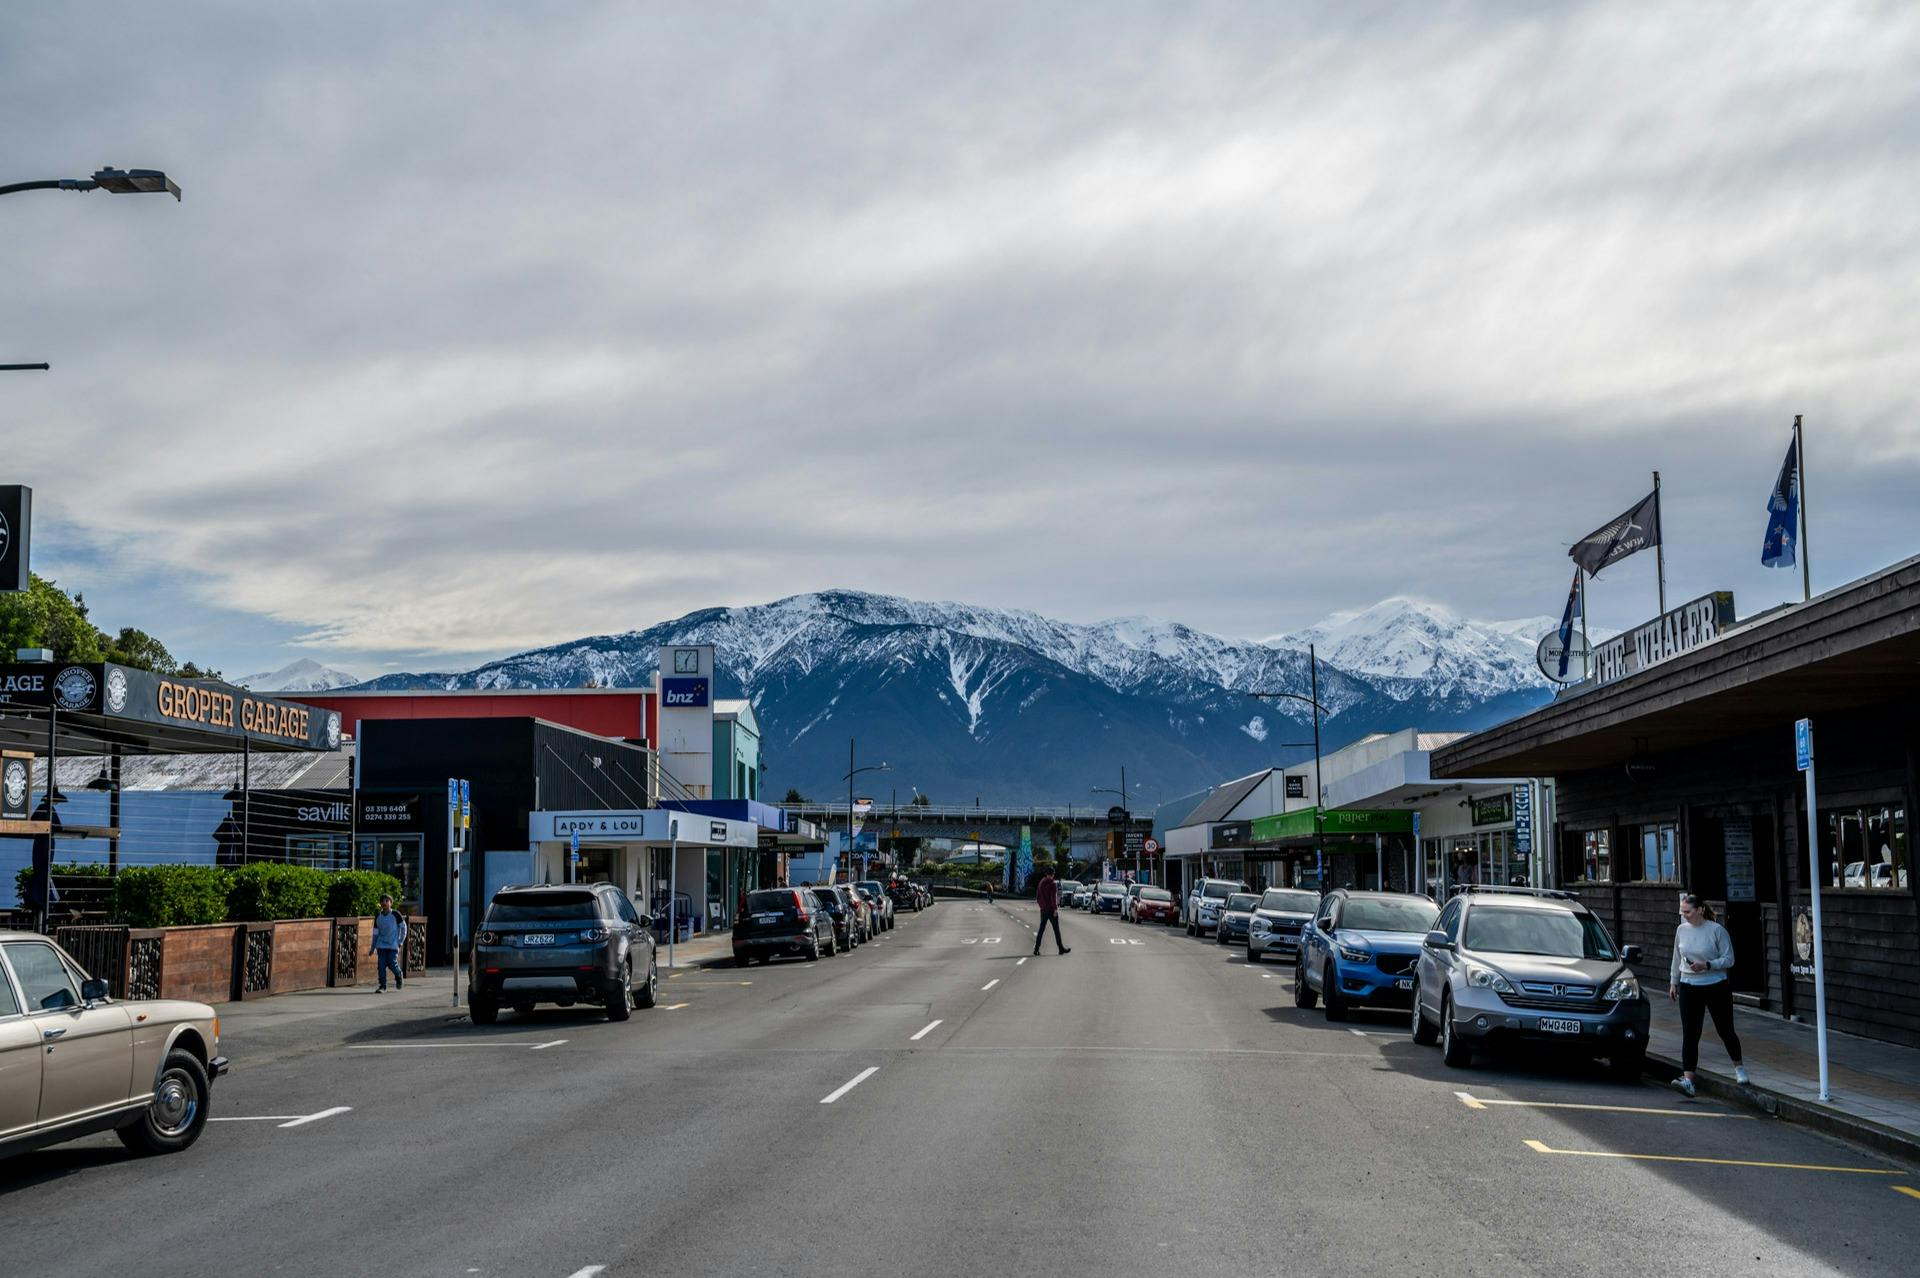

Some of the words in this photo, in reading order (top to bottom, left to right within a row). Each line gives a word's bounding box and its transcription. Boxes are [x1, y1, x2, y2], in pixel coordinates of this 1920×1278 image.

[1591, 636, 1627, 685] THE
[1634, 597, 1718, 670] WHALER
[58, 667, 93, 683] GROPER
[58, 696, 90, 709] GARAGE
[666, 689, 694, 703] bnz
[158, 680, 234, 727] GROPER
[240, 697, 309, 740] GARAGE
[1338, 813, 1370, 824] paper
[1515, 786, 1530, 839] SOUVENIRS
[560, 822, 594, 831] ADDY
[600, 822, 607, 830] &
[613, 821, 637, 830] LOU
